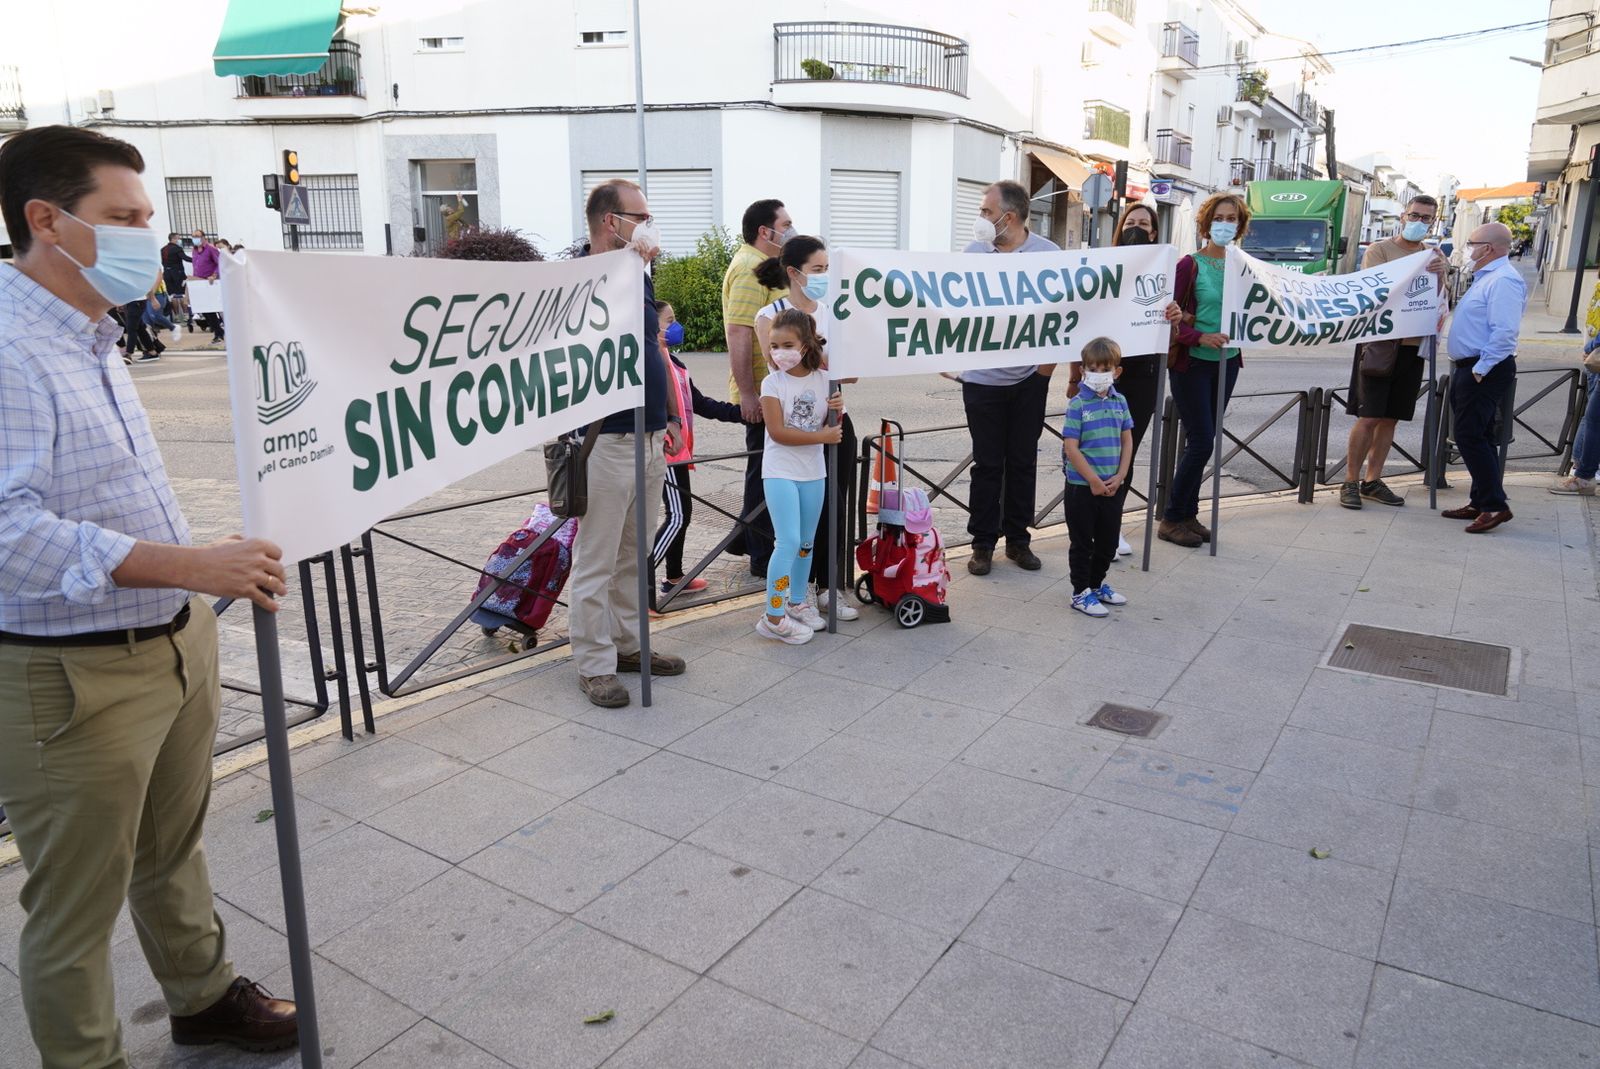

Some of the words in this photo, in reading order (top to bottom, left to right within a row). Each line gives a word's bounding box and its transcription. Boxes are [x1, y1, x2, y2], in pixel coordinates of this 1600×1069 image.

[832, 257, 1124, 321] ¿CONCILIACIÓN
[1315, 279, 1363, 297] AÑOS
[1361, 272, 1393, 288] DE
[390, 273, 610, 375] SEGUIMOS
[887, 310, 1080, 358] FAMILIAR?
[1229, 308, 1394, 346] INCUMPLIDAS
[344, 380, 436, 492] SIN
[446, 333, 643, 446] COMEDOR
[263, 427, 318, 454] ampa
[279, 455, 308, 469] Cano
